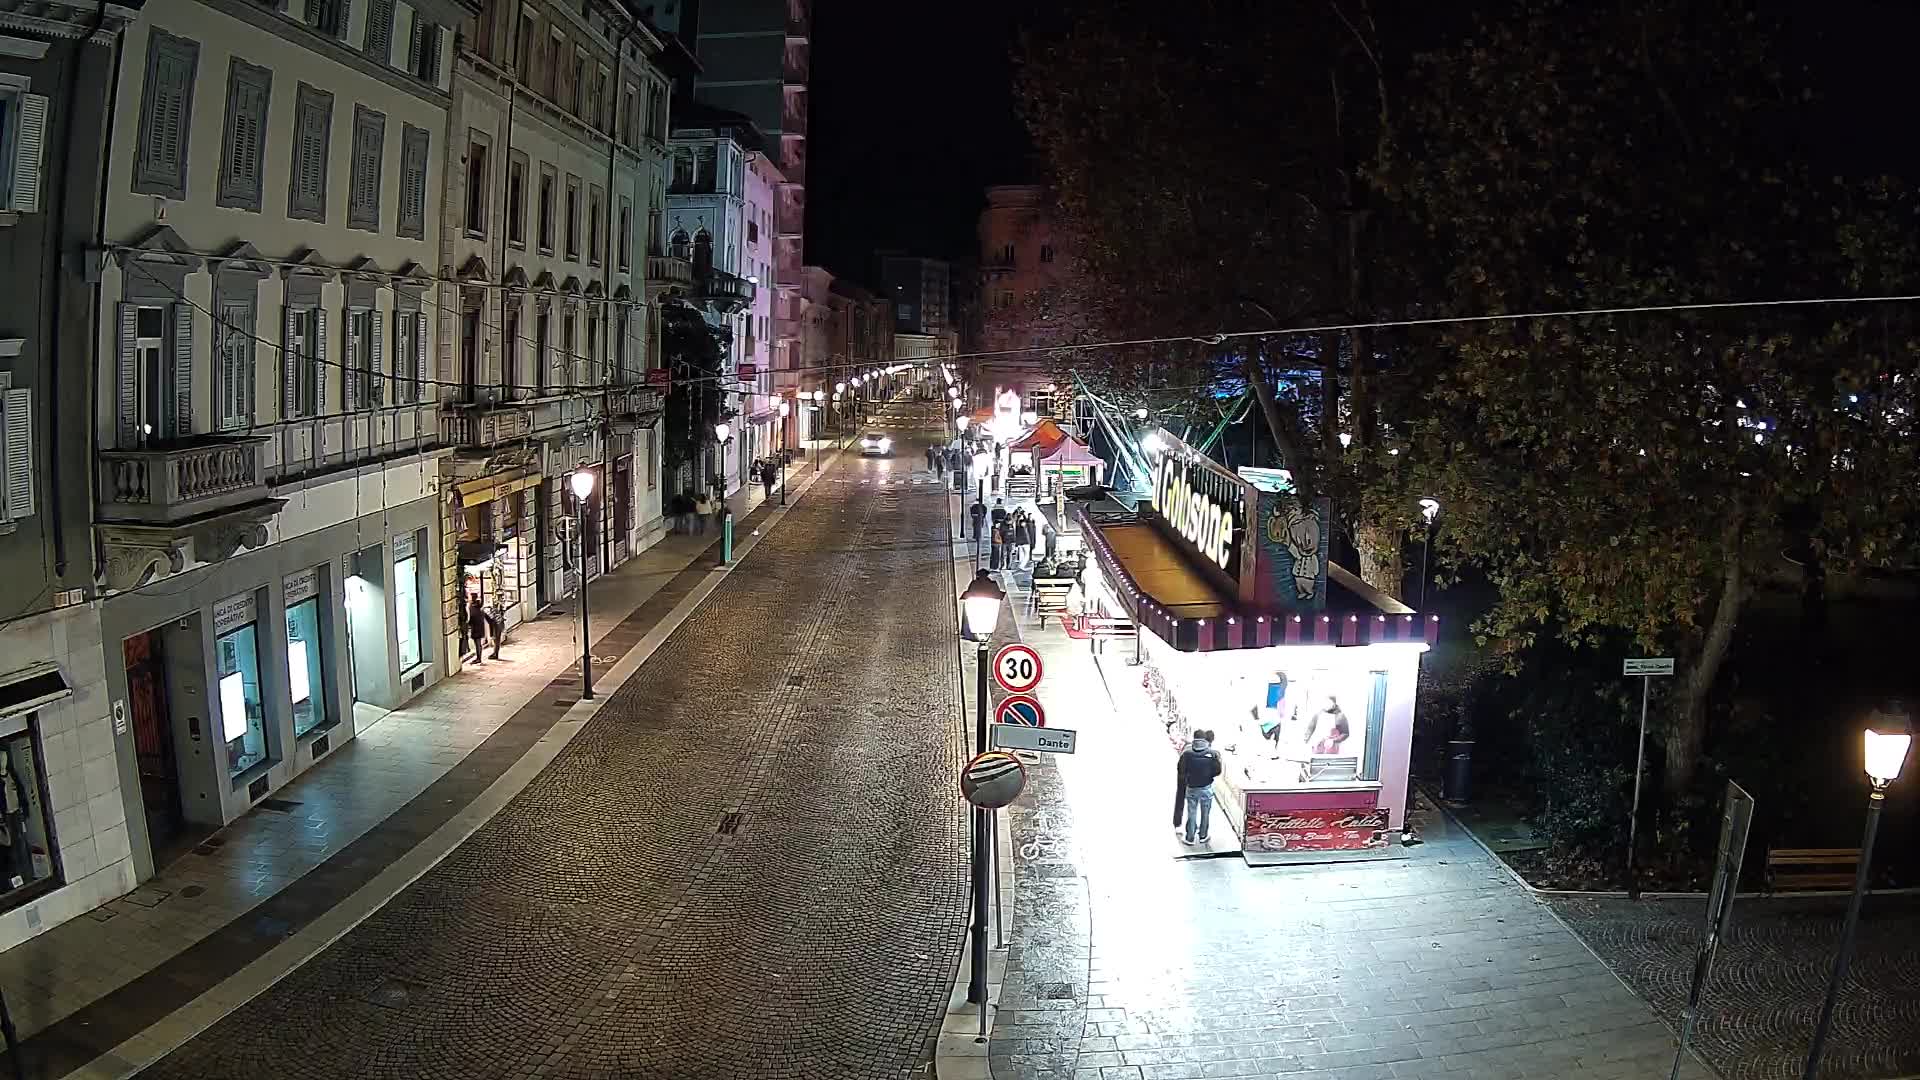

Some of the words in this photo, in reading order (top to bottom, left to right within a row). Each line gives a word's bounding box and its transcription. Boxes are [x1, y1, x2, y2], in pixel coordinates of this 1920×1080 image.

[1162, 458, 1233, 570] Golosone
[233, 597, 254, 611] CREDITO
[215, 611, 245, 628] OPERATIVO
[1006, 658, 1032, 679] 30
[1038, 737, 1069, 749] Dante
